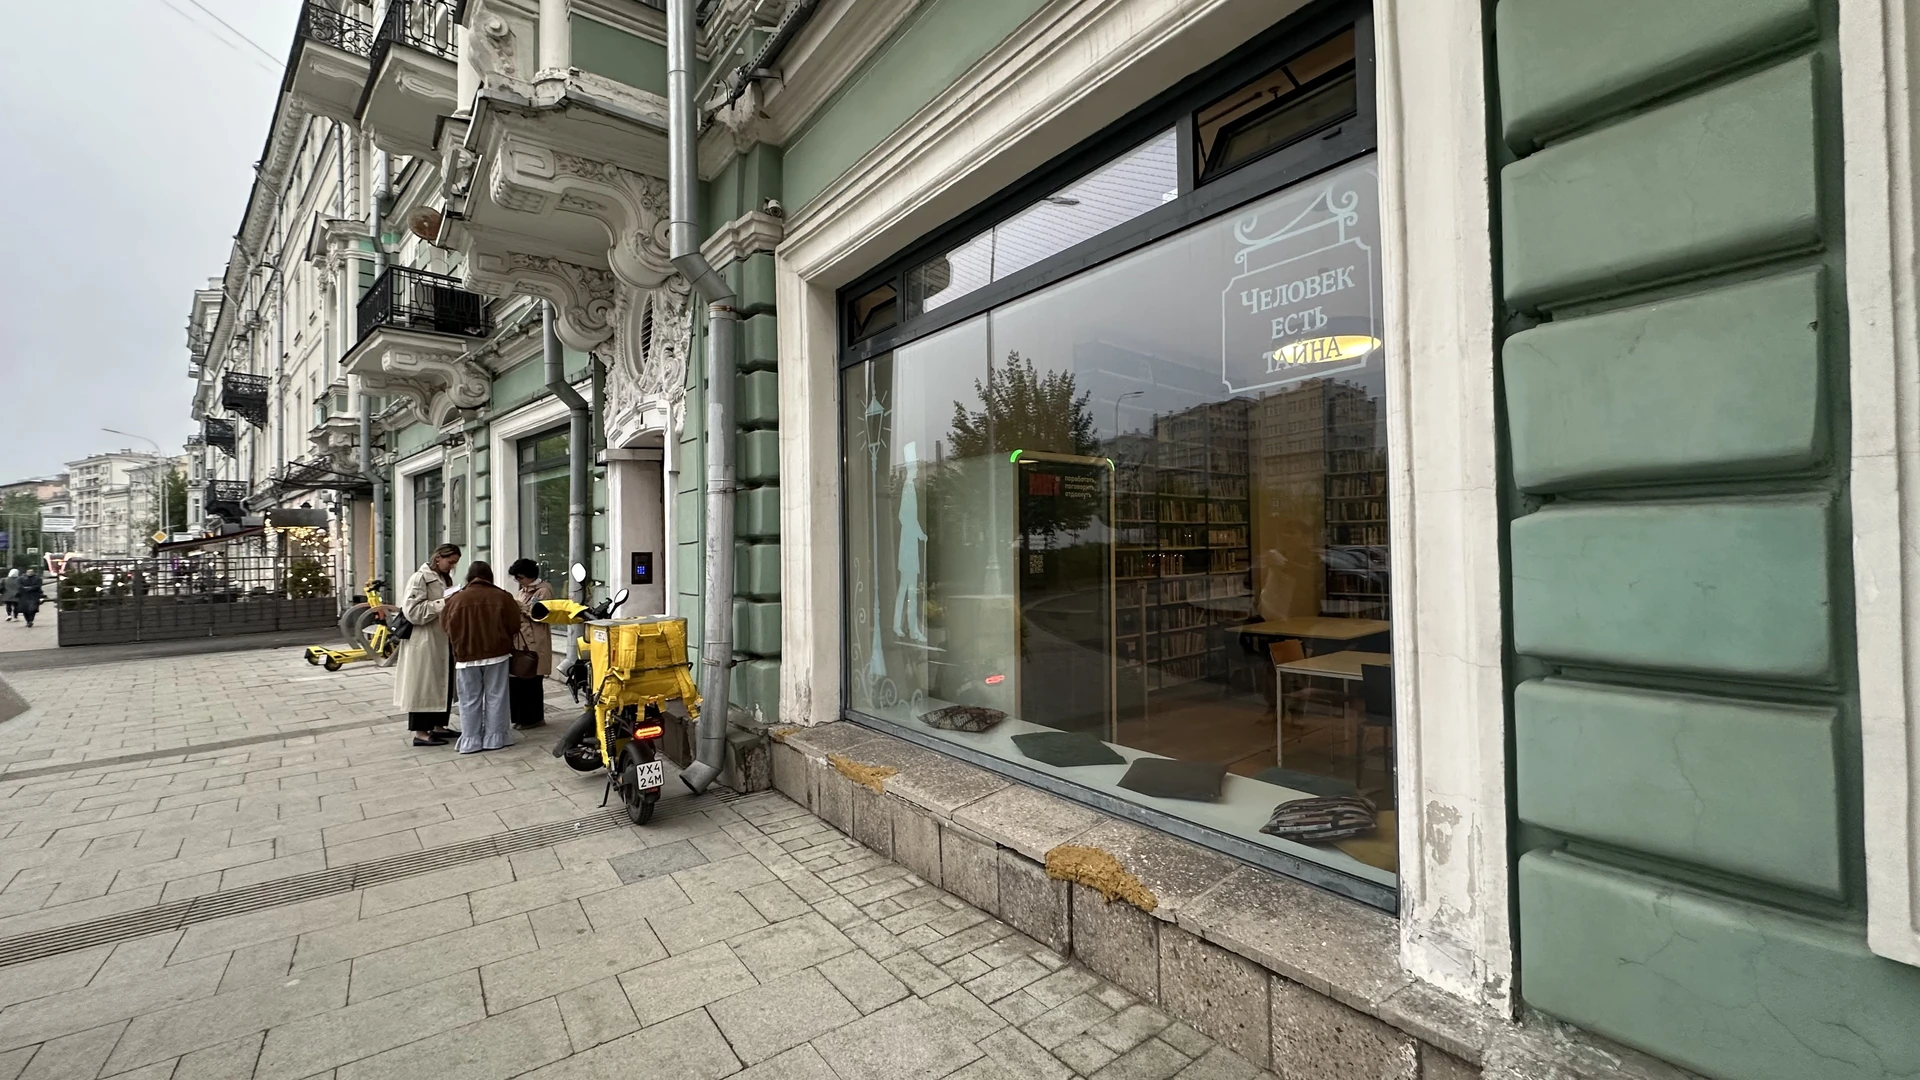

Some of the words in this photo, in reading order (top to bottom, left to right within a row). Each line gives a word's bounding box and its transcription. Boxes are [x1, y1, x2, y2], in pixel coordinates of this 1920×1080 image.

[1240, 265, 1356, 315] ЧЕЛОВЕК
[1271, 306, 1328, 340] ЕСТЬ
[1262, 336, 1343, 374] ТАЙНА
